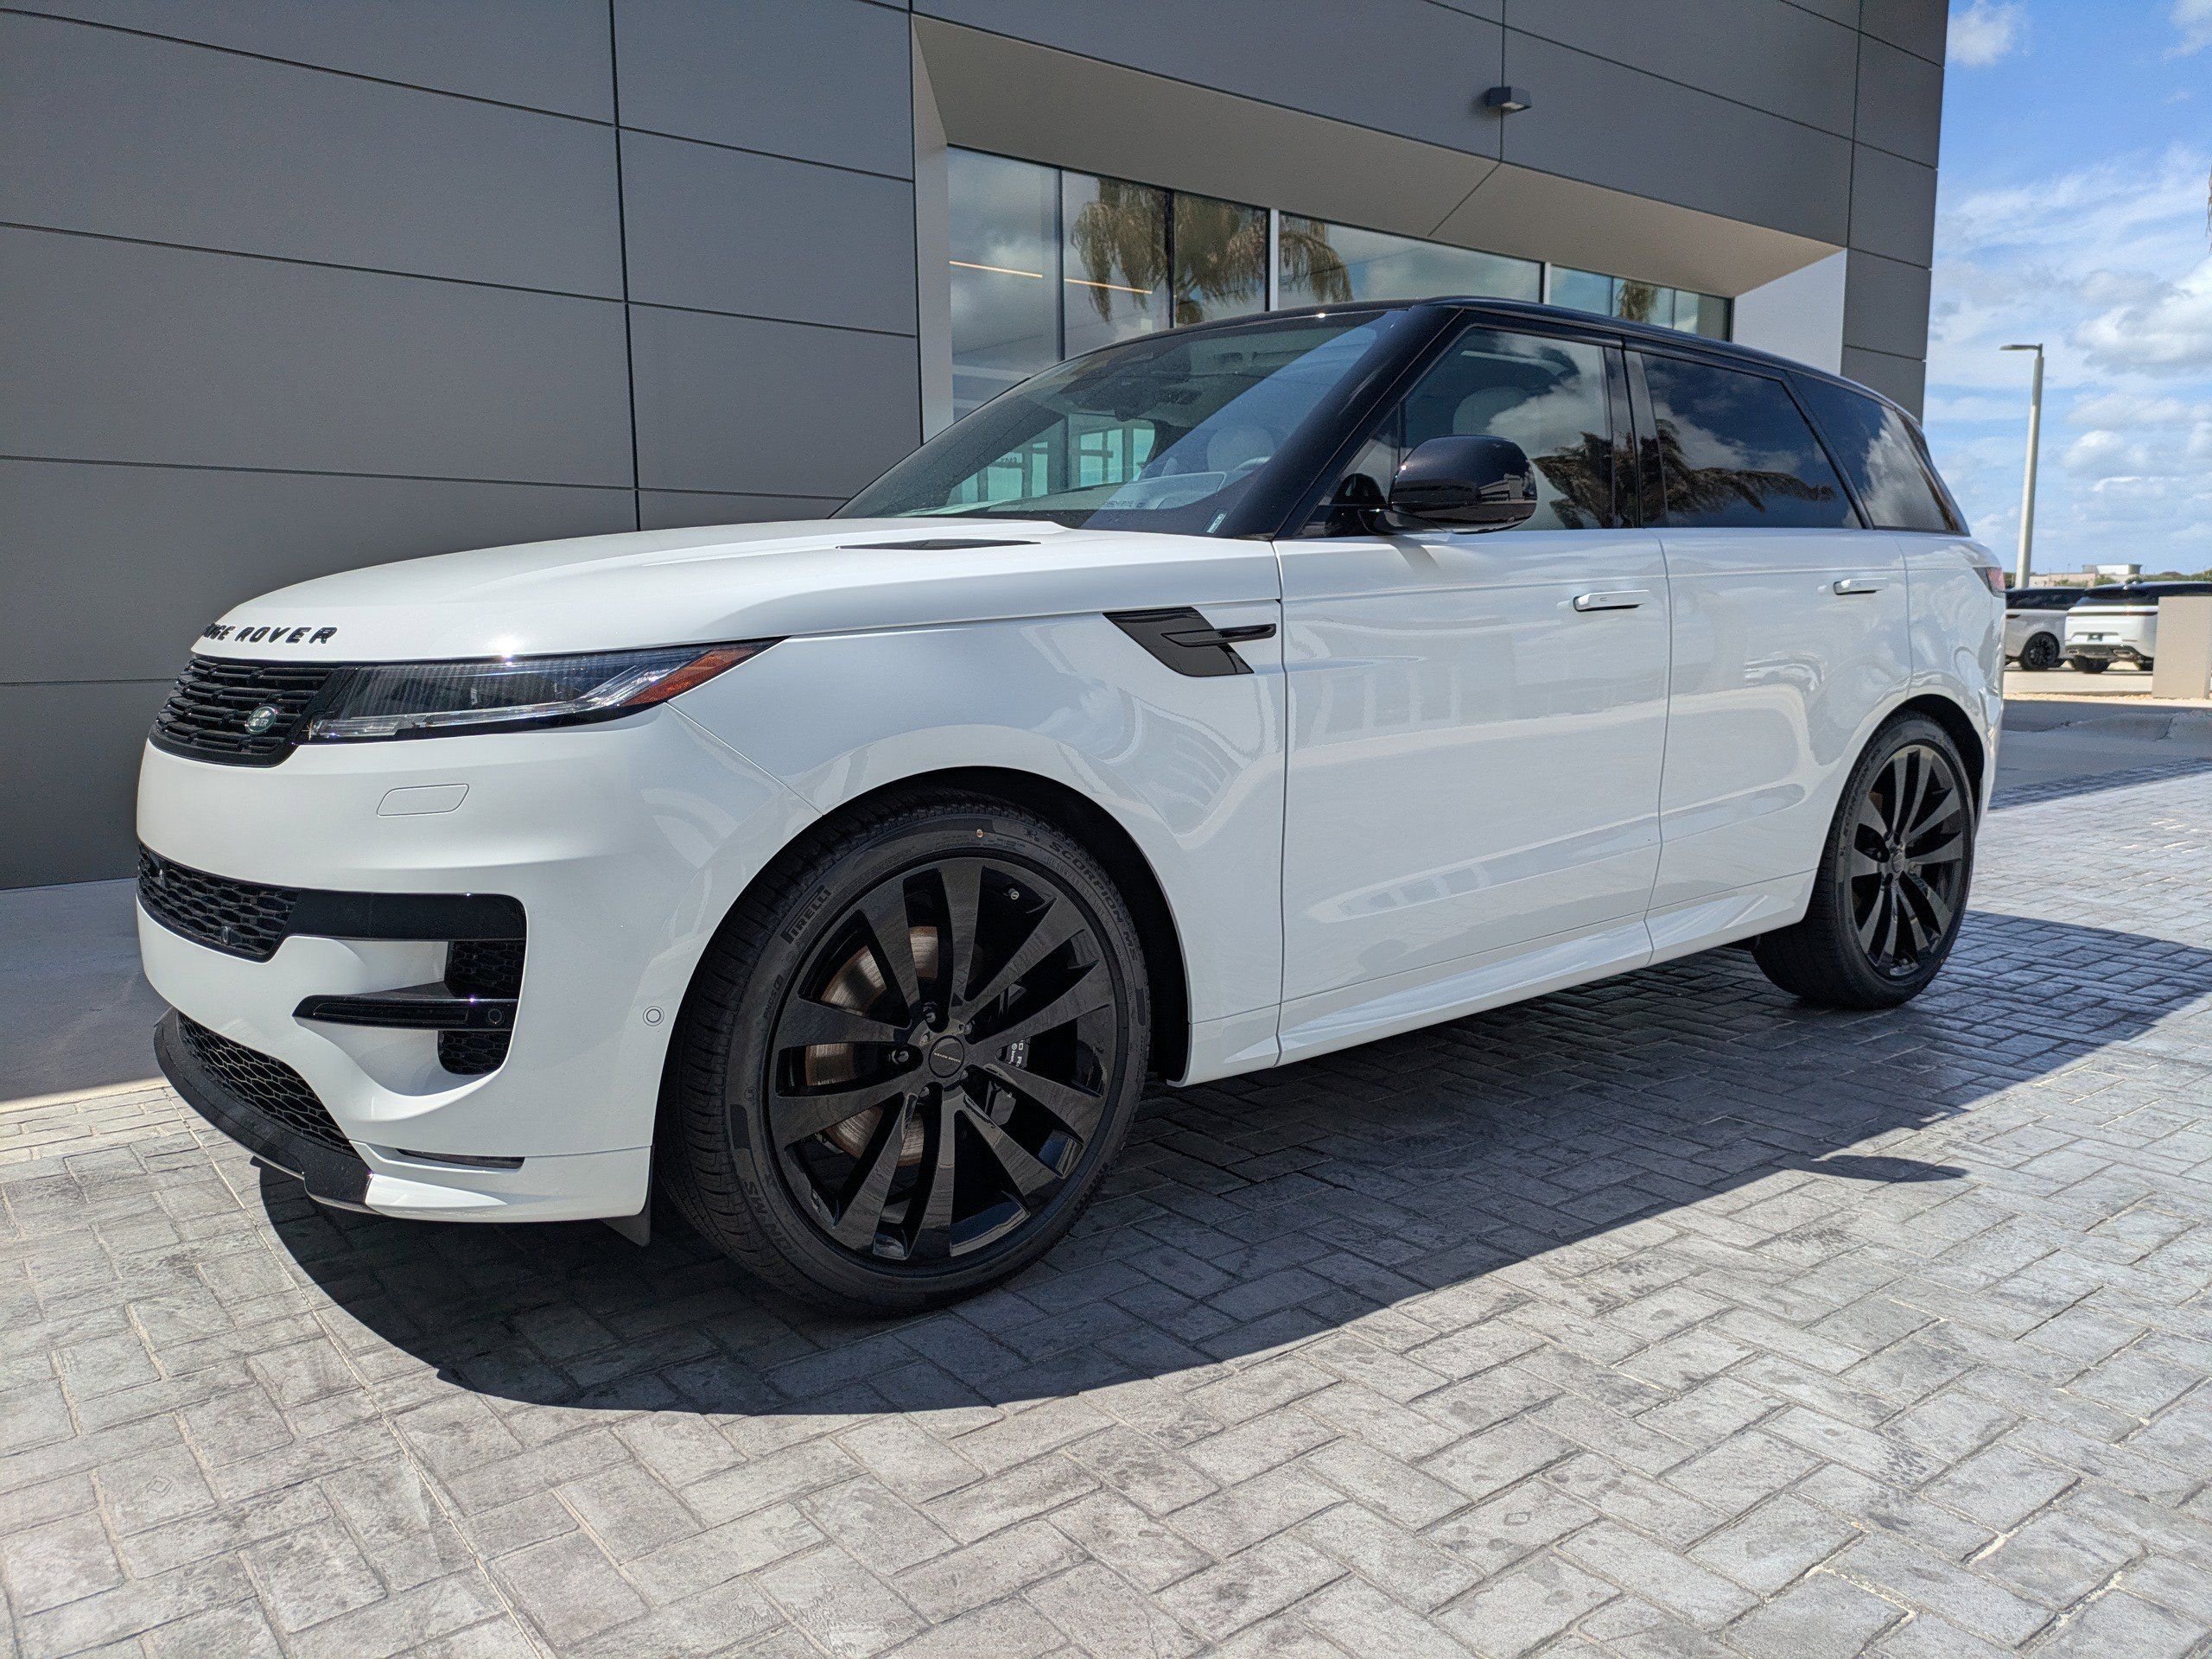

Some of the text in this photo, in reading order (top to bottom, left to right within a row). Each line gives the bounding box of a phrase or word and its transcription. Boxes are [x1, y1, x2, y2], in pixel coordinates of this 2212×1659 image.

[234, 626, 338, 644] ROVER
[1049, 841, 1123, 923] SCORPION
[779, 885, 831, 944] PIRELLI
